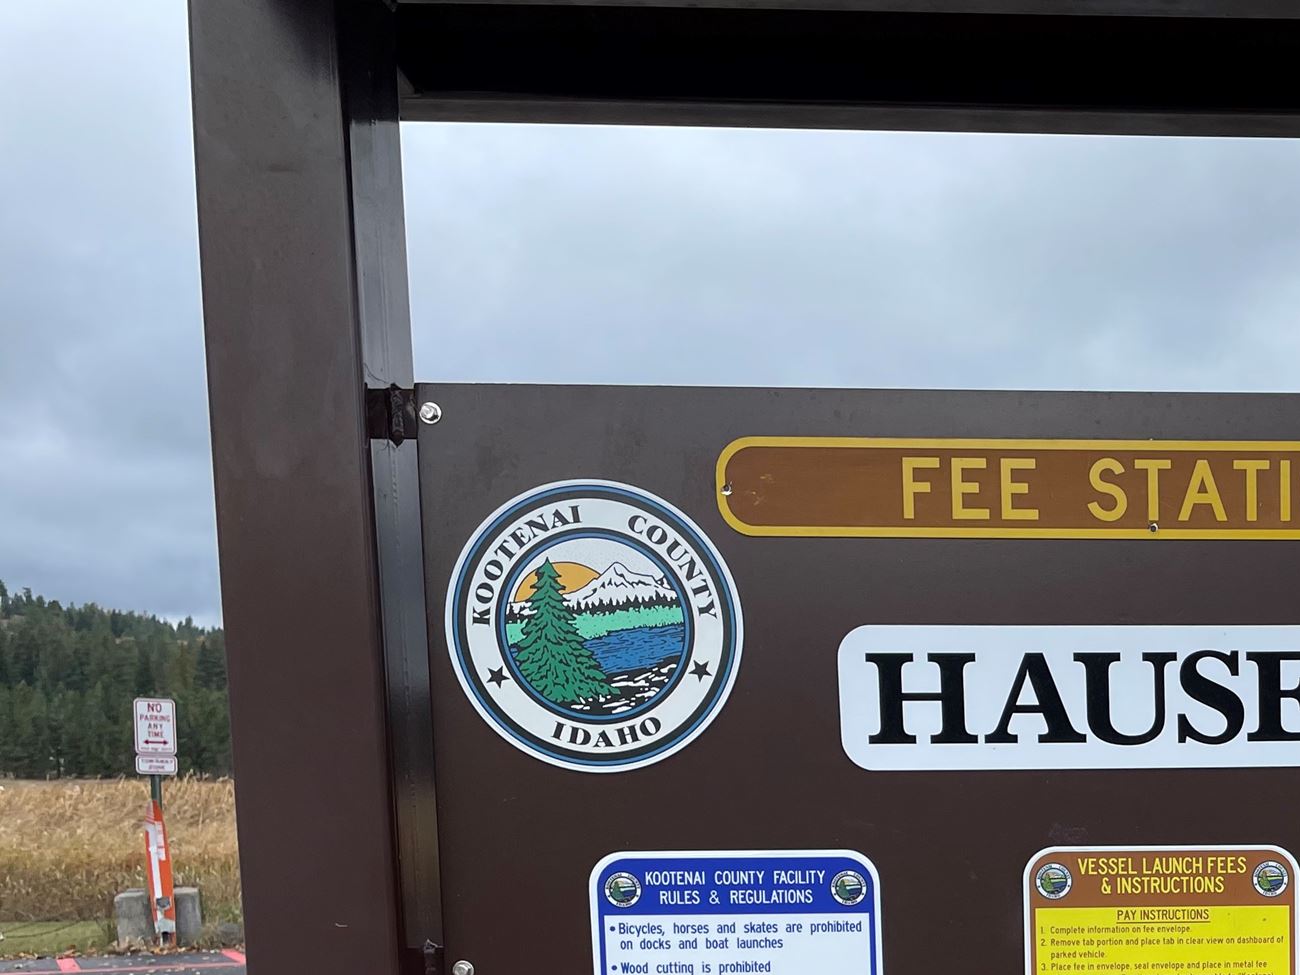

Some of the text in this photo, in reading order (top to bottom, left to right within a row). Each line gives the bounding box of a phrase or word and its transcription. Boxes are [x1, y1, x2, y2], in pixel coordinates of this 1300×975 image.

[903, 457, 1039, 520] FEE
[472, 505, 718, 626] KOOTENAI COUNTY
[147, 703, 162, 712] NO
[139, 714, 170, 723] PARKING
[551, 716, 662, 748] IDAHO
[1077, 856, 1247, 875] VESSEL LAUNCH FEES
[644, 869, 826, 886] KOOTENAI COUNTY FACILITY
[1101, 875, 1225, 895] & INSTRUCTIONS
[659, 890, 701, 905] RULES
[708, 889, 721, 905] &
[729, 888, 814, 905] REGULATIONS
[1115, 908, 1210, 921] PAY INSTRUCTIONS
[618, 920, 863, 938] Bicycles, horses and skates are prohibited
[1049, 925, 1086, 936] Complete
[1087, 925, 1131, 934] information
[1131, 926, 1142, 934] on
[1142, 924, 1155, 934] fee
[619, 936, 784, 951] on docks and boat launches
[620, 961, 649, 975] Wood
[701, 960, 712, 974] is
